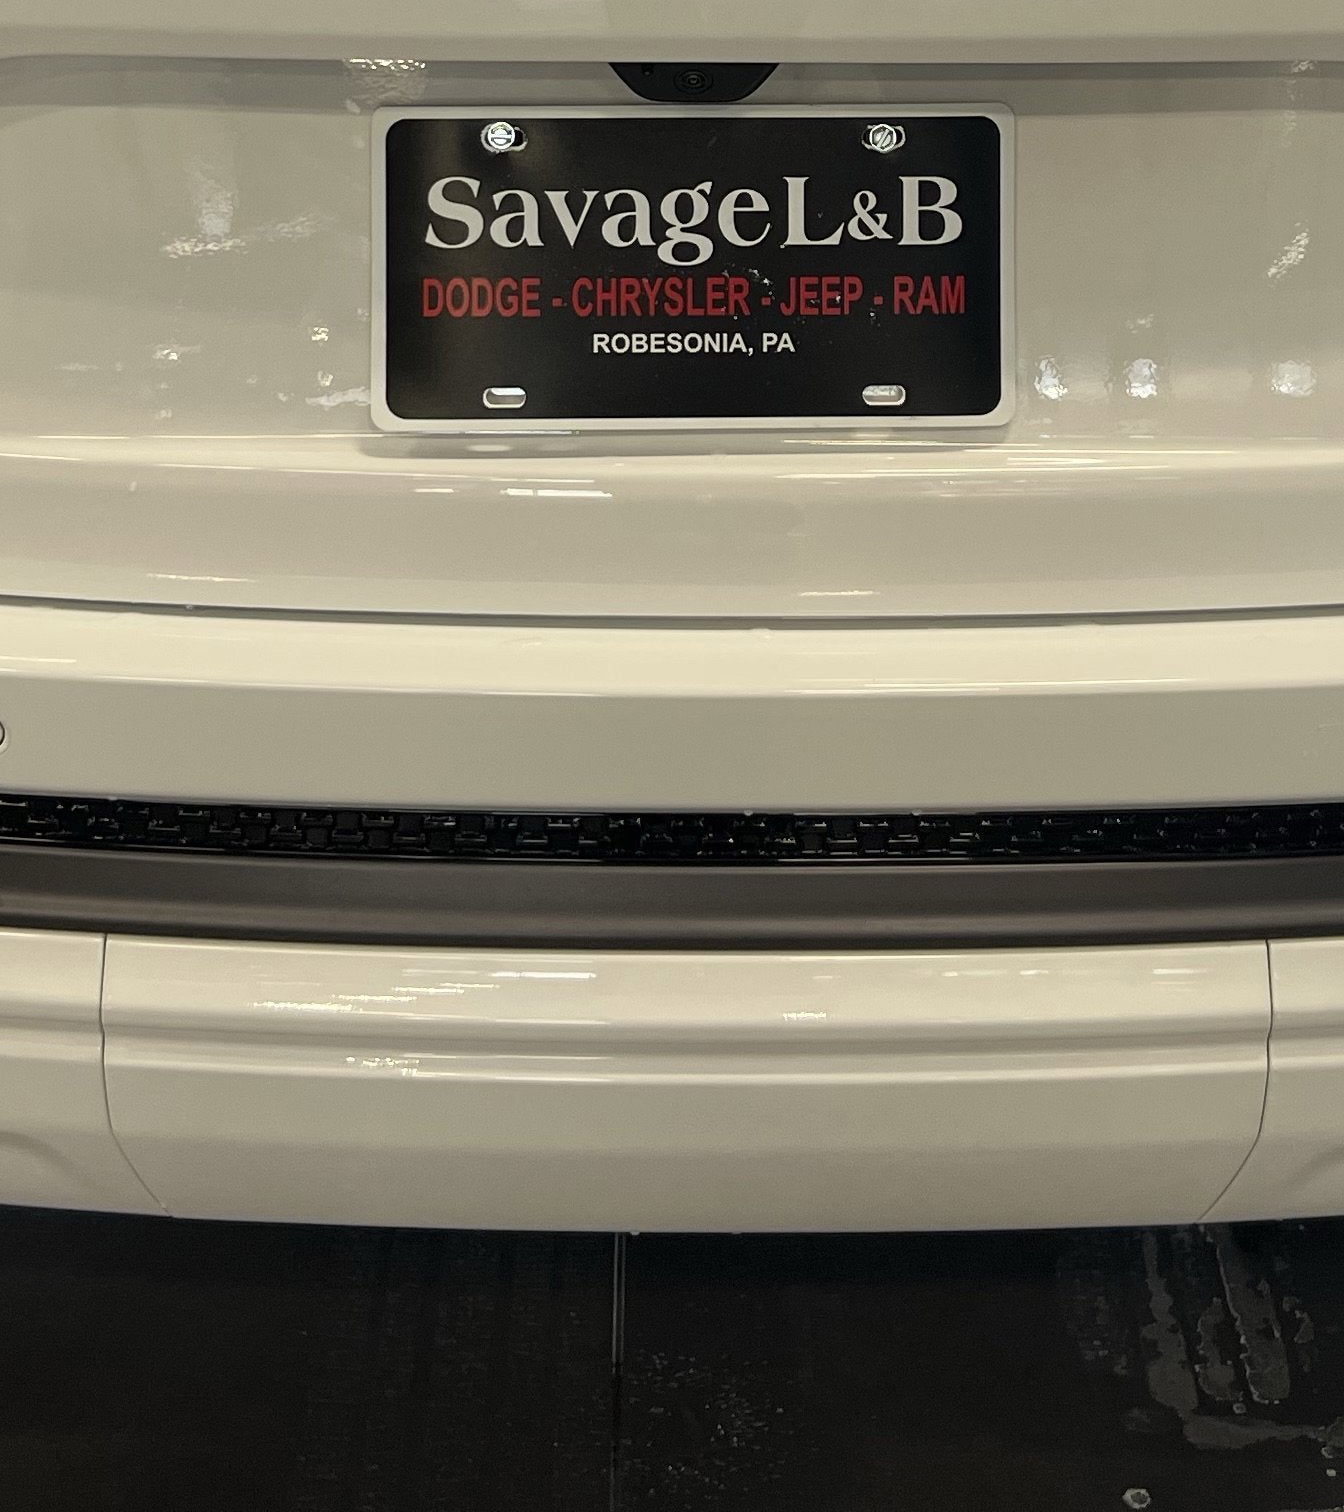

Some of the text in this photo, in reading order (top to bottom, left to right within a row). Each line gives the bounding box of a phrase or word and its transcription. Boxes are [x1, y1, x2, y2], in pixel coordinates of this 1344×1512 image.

[421, 277, 541, 317] DODGE
[571, 275, 751, 317] CHRYSLER
[779, 275, 863, 316] JEEP
[893, 274, 966, 315] RAM
[592, 332, 796, 357] ROBESONIA, PA
